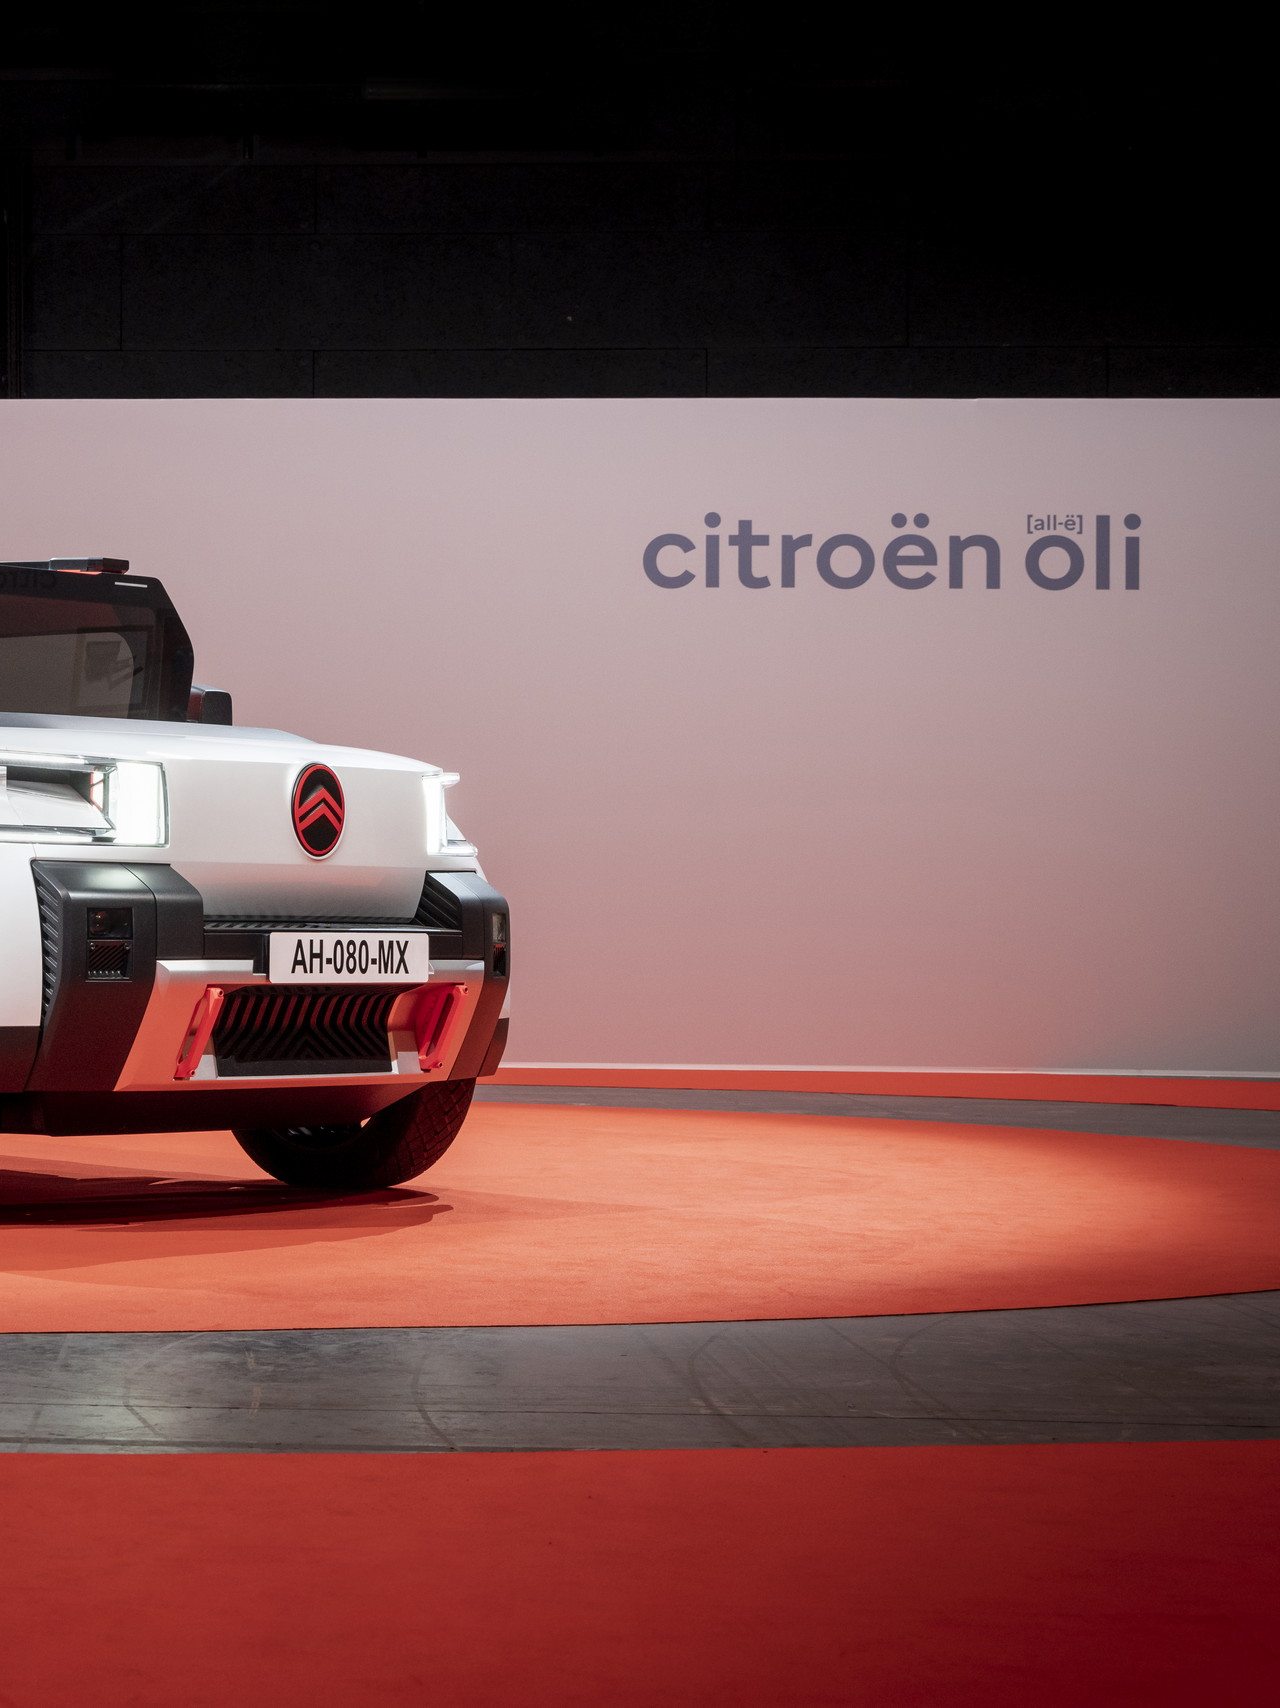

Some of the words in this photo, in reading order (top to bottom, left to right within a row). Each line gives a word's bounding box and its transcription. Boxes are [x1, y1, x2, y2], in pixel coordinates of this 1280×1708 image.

[1026, 514, 1084, 535] [all-ë]
[642, 511, 1003, 591] citroën
[1024, 512, 1142, 592] oli
[290, 938, 410, 975] AH-080-MX
